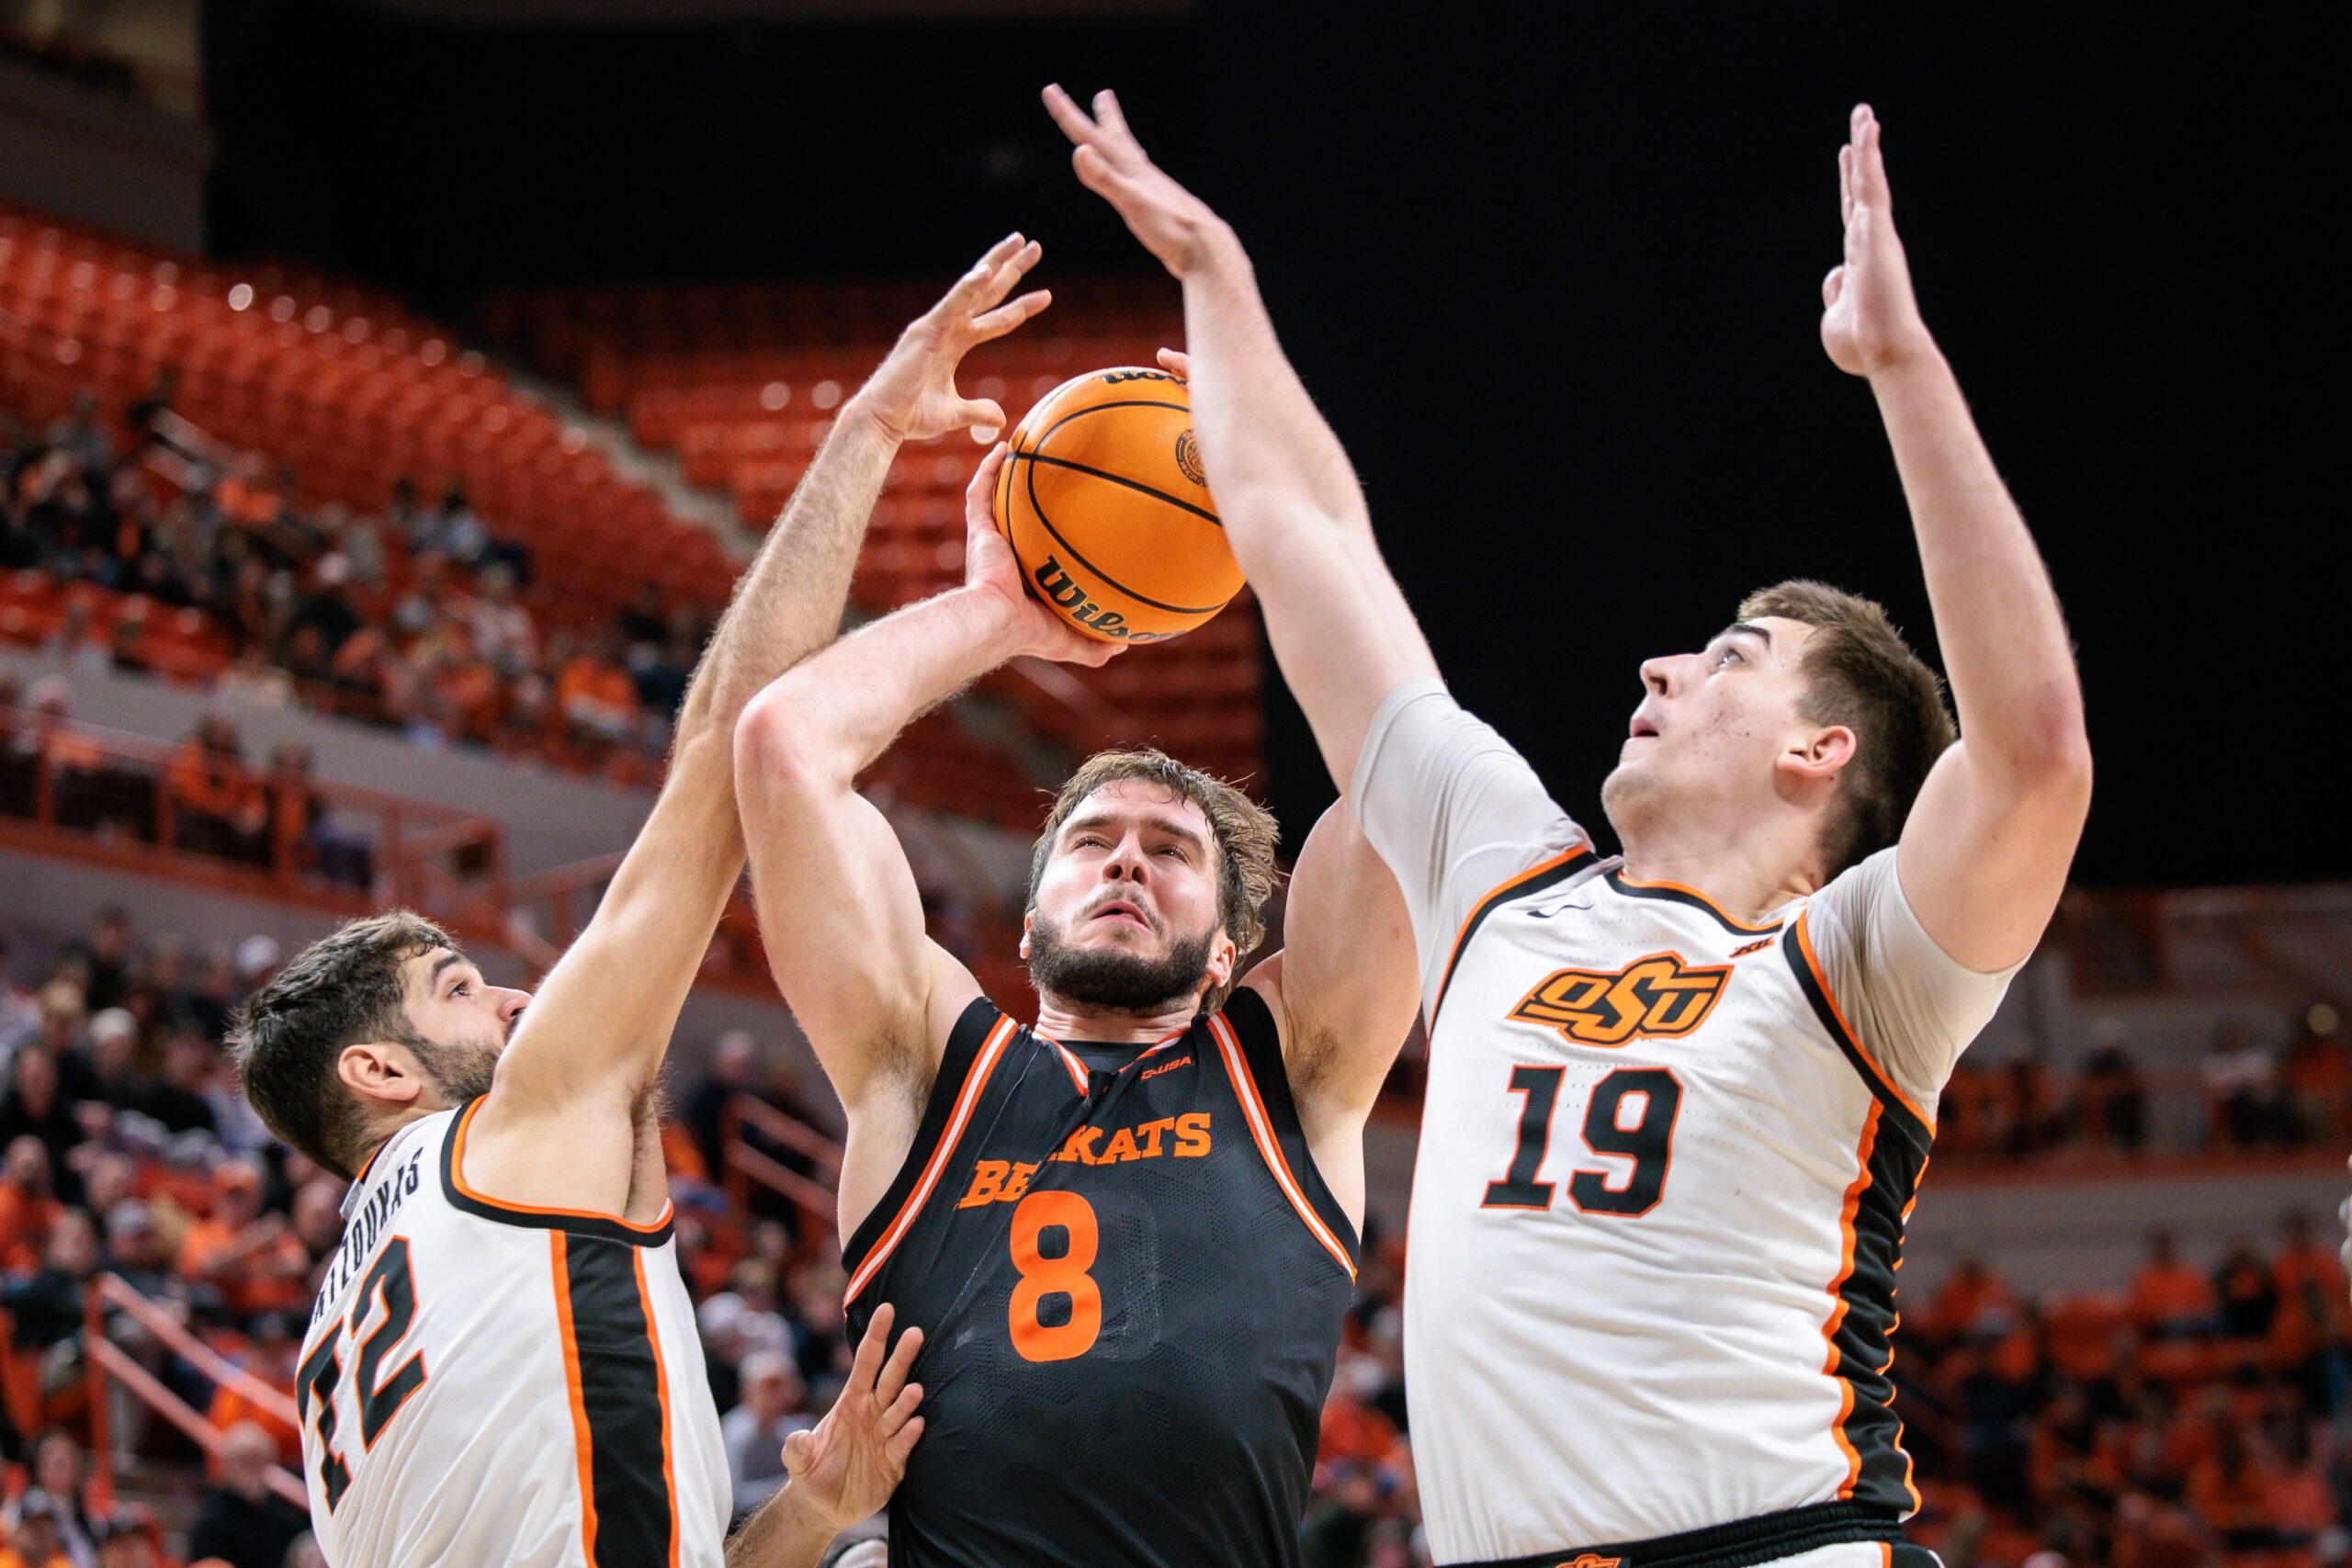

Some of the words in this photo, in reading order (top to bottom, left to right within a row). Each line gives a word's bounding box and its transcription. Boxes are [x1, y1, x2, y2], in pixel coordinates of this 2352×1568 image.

[1505, 951, 1735, 1048] OSU
[1140, 1055, 1192, 1082] C-USA
[953, 1112, 1211, 1211] BEKATS
[1480, 1064, 1683, 1218] 19
[1008, 1190, 1102, 1362] 8
